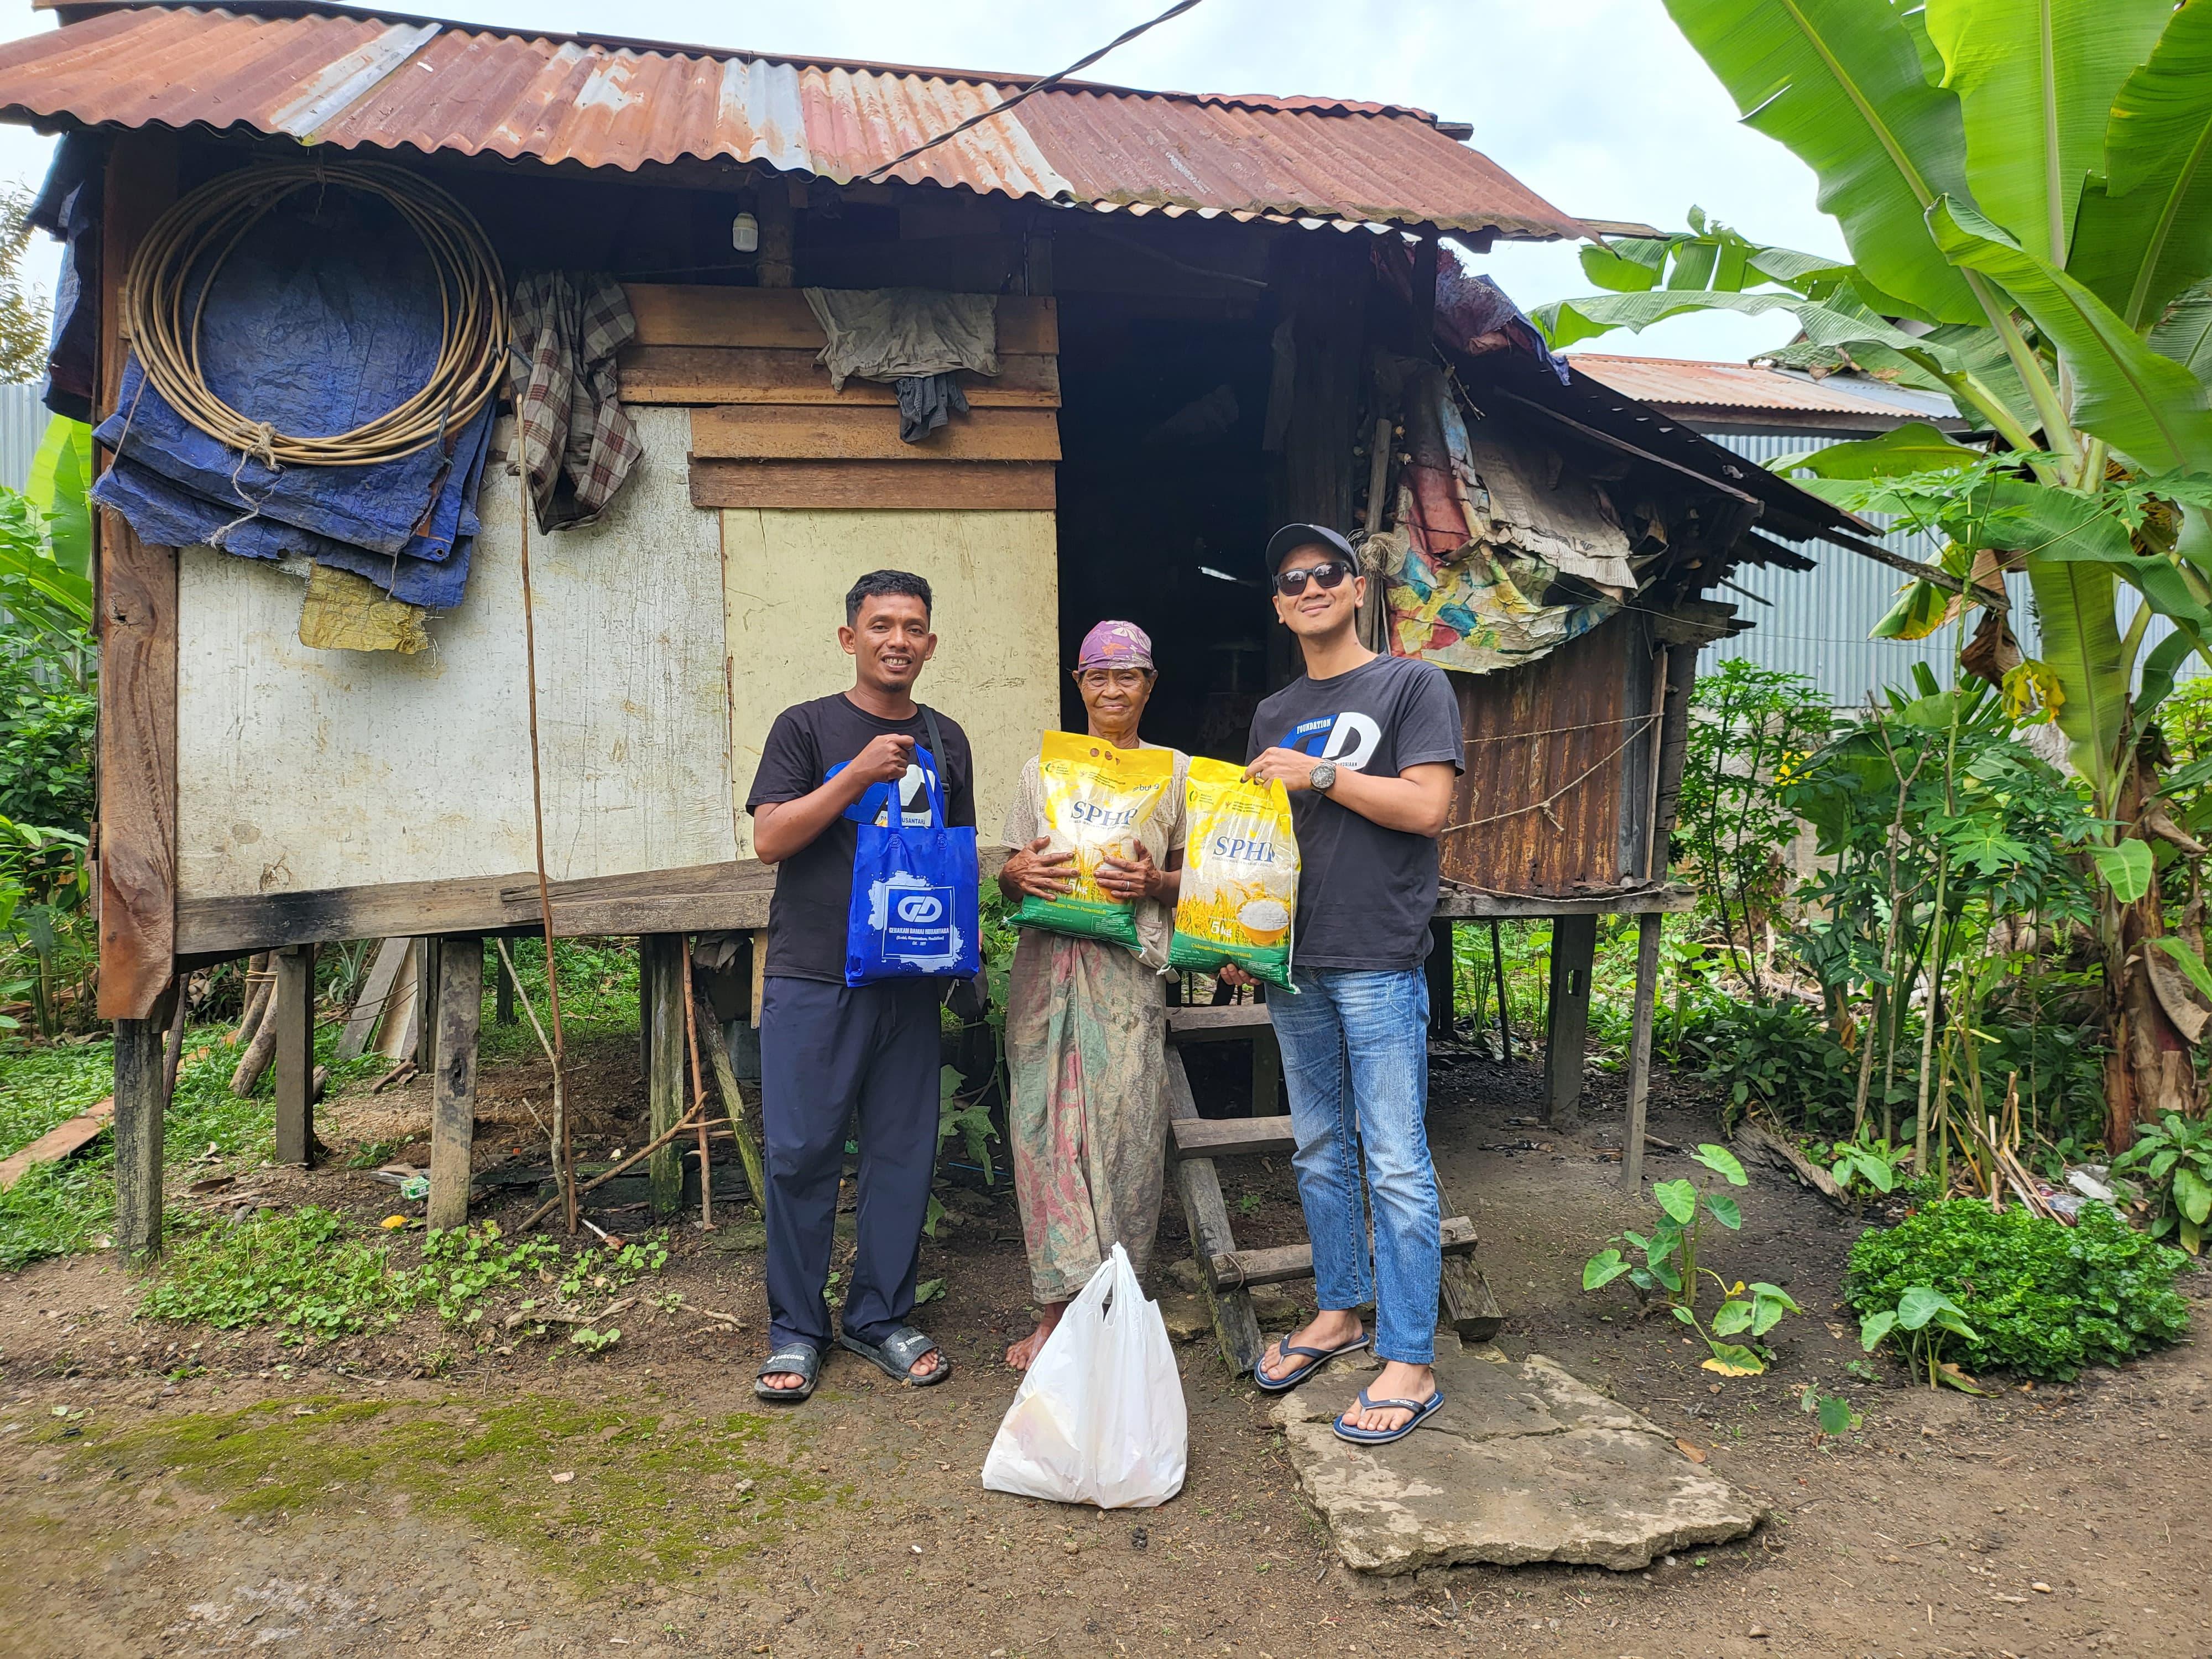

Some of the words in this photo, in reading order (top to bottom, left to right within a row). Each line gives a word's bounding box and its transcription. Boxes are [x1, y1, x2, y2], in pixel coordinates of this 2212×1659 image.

[1296, 718, 1331, 734] FOUNDATION
[1071, 801, 1138, 827] SPHP
[1211, 921, 1220, 935] 5
